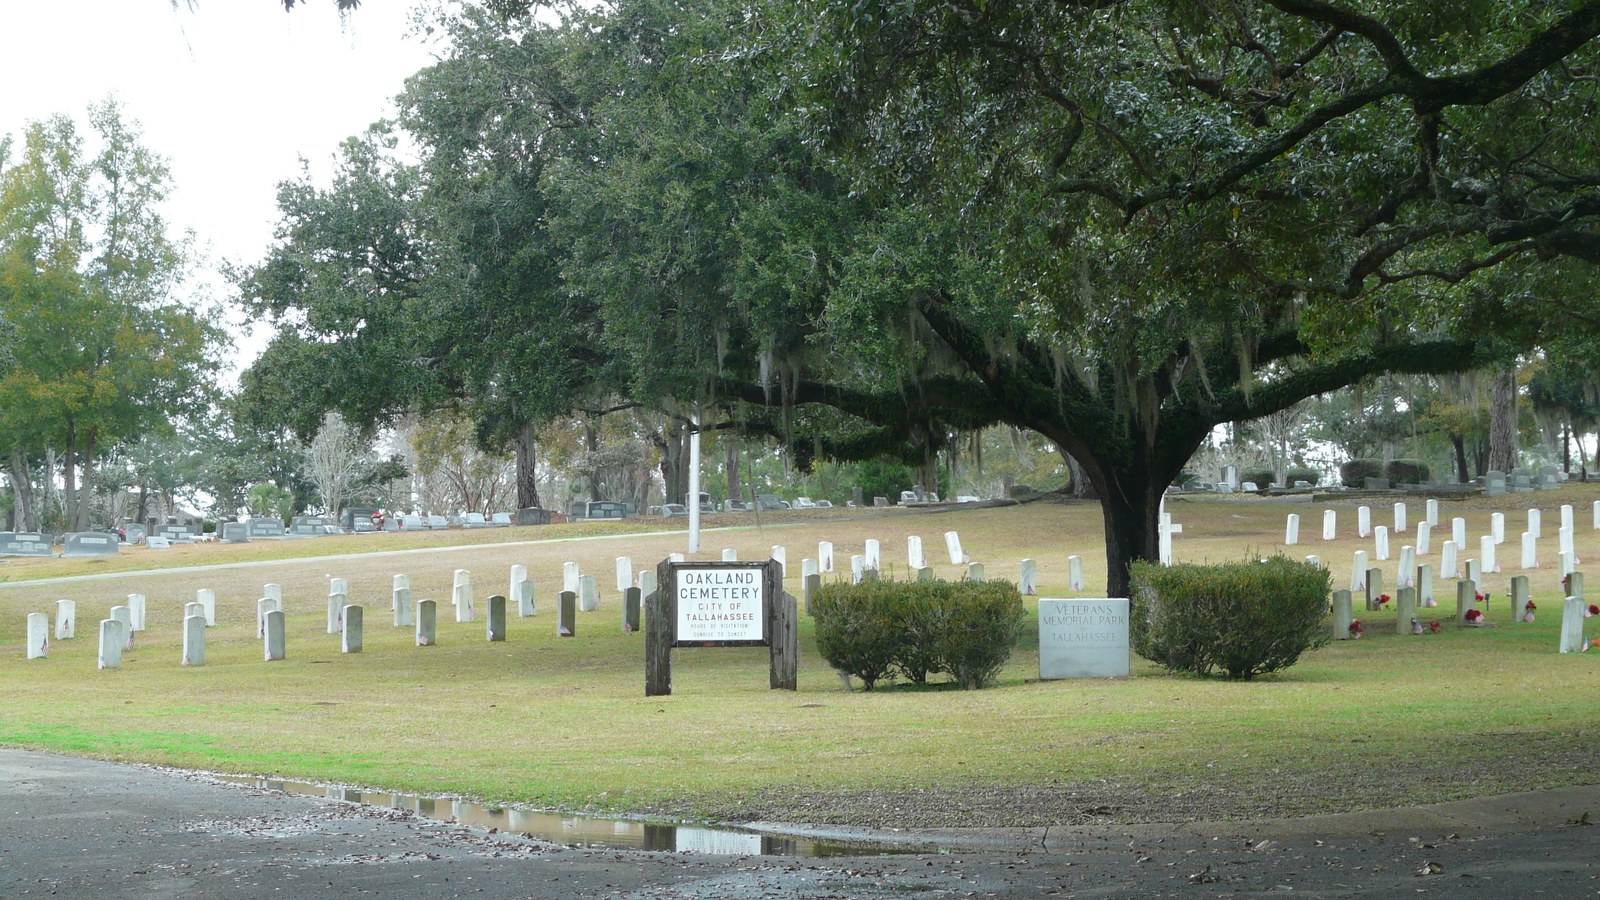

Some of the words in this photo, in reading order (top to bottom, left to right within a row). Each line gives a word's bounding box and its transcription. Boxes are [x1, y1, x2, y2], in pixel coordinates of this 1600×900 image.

[685, 572, 754, 585] OAKLAND
[680, 587, 759, 599] CEMETERY
[698, 602, 722, 610] CITY
[729, 602, 741, 610] OF
[1056, 605, 1113, 616] VETERANS
[686, 612, 754, 621] TALLAHASSEE
[1043, 616, 1096, 626] MEMORIAL
[1099, 615, 1125, 625] PARK
[1052, 632, 1118, 642] TALLAHASSEE
